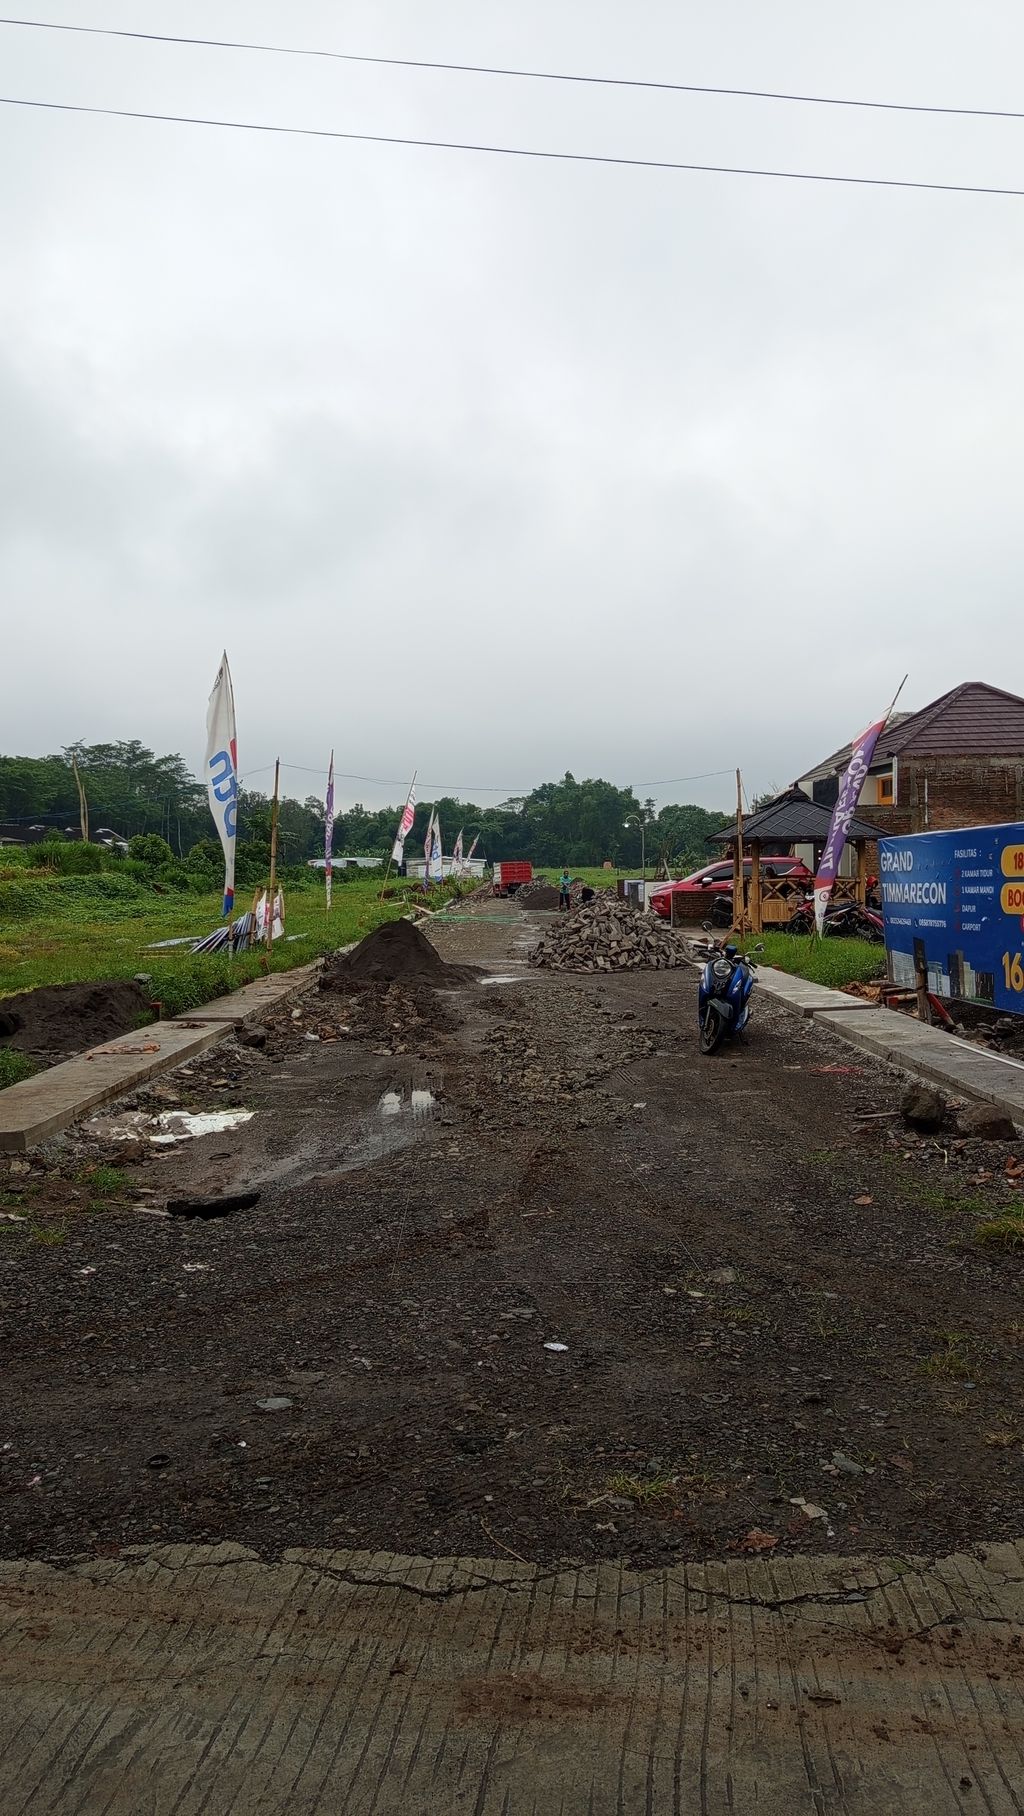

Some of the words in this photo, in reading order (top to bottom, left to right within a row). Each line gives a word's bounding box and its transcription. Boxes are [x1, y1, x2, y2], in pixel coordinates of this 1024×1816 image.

[954, 849, 977, 859] FASILITAS
[881, 851, 913, 872] GRAND
[882, 882, 947, 905] TIMMARECON
[1008, 888, 1024, 907] BO
[961, 904, 977, 913] DAPUR
[961, 922, 981, 931] CARPORT
